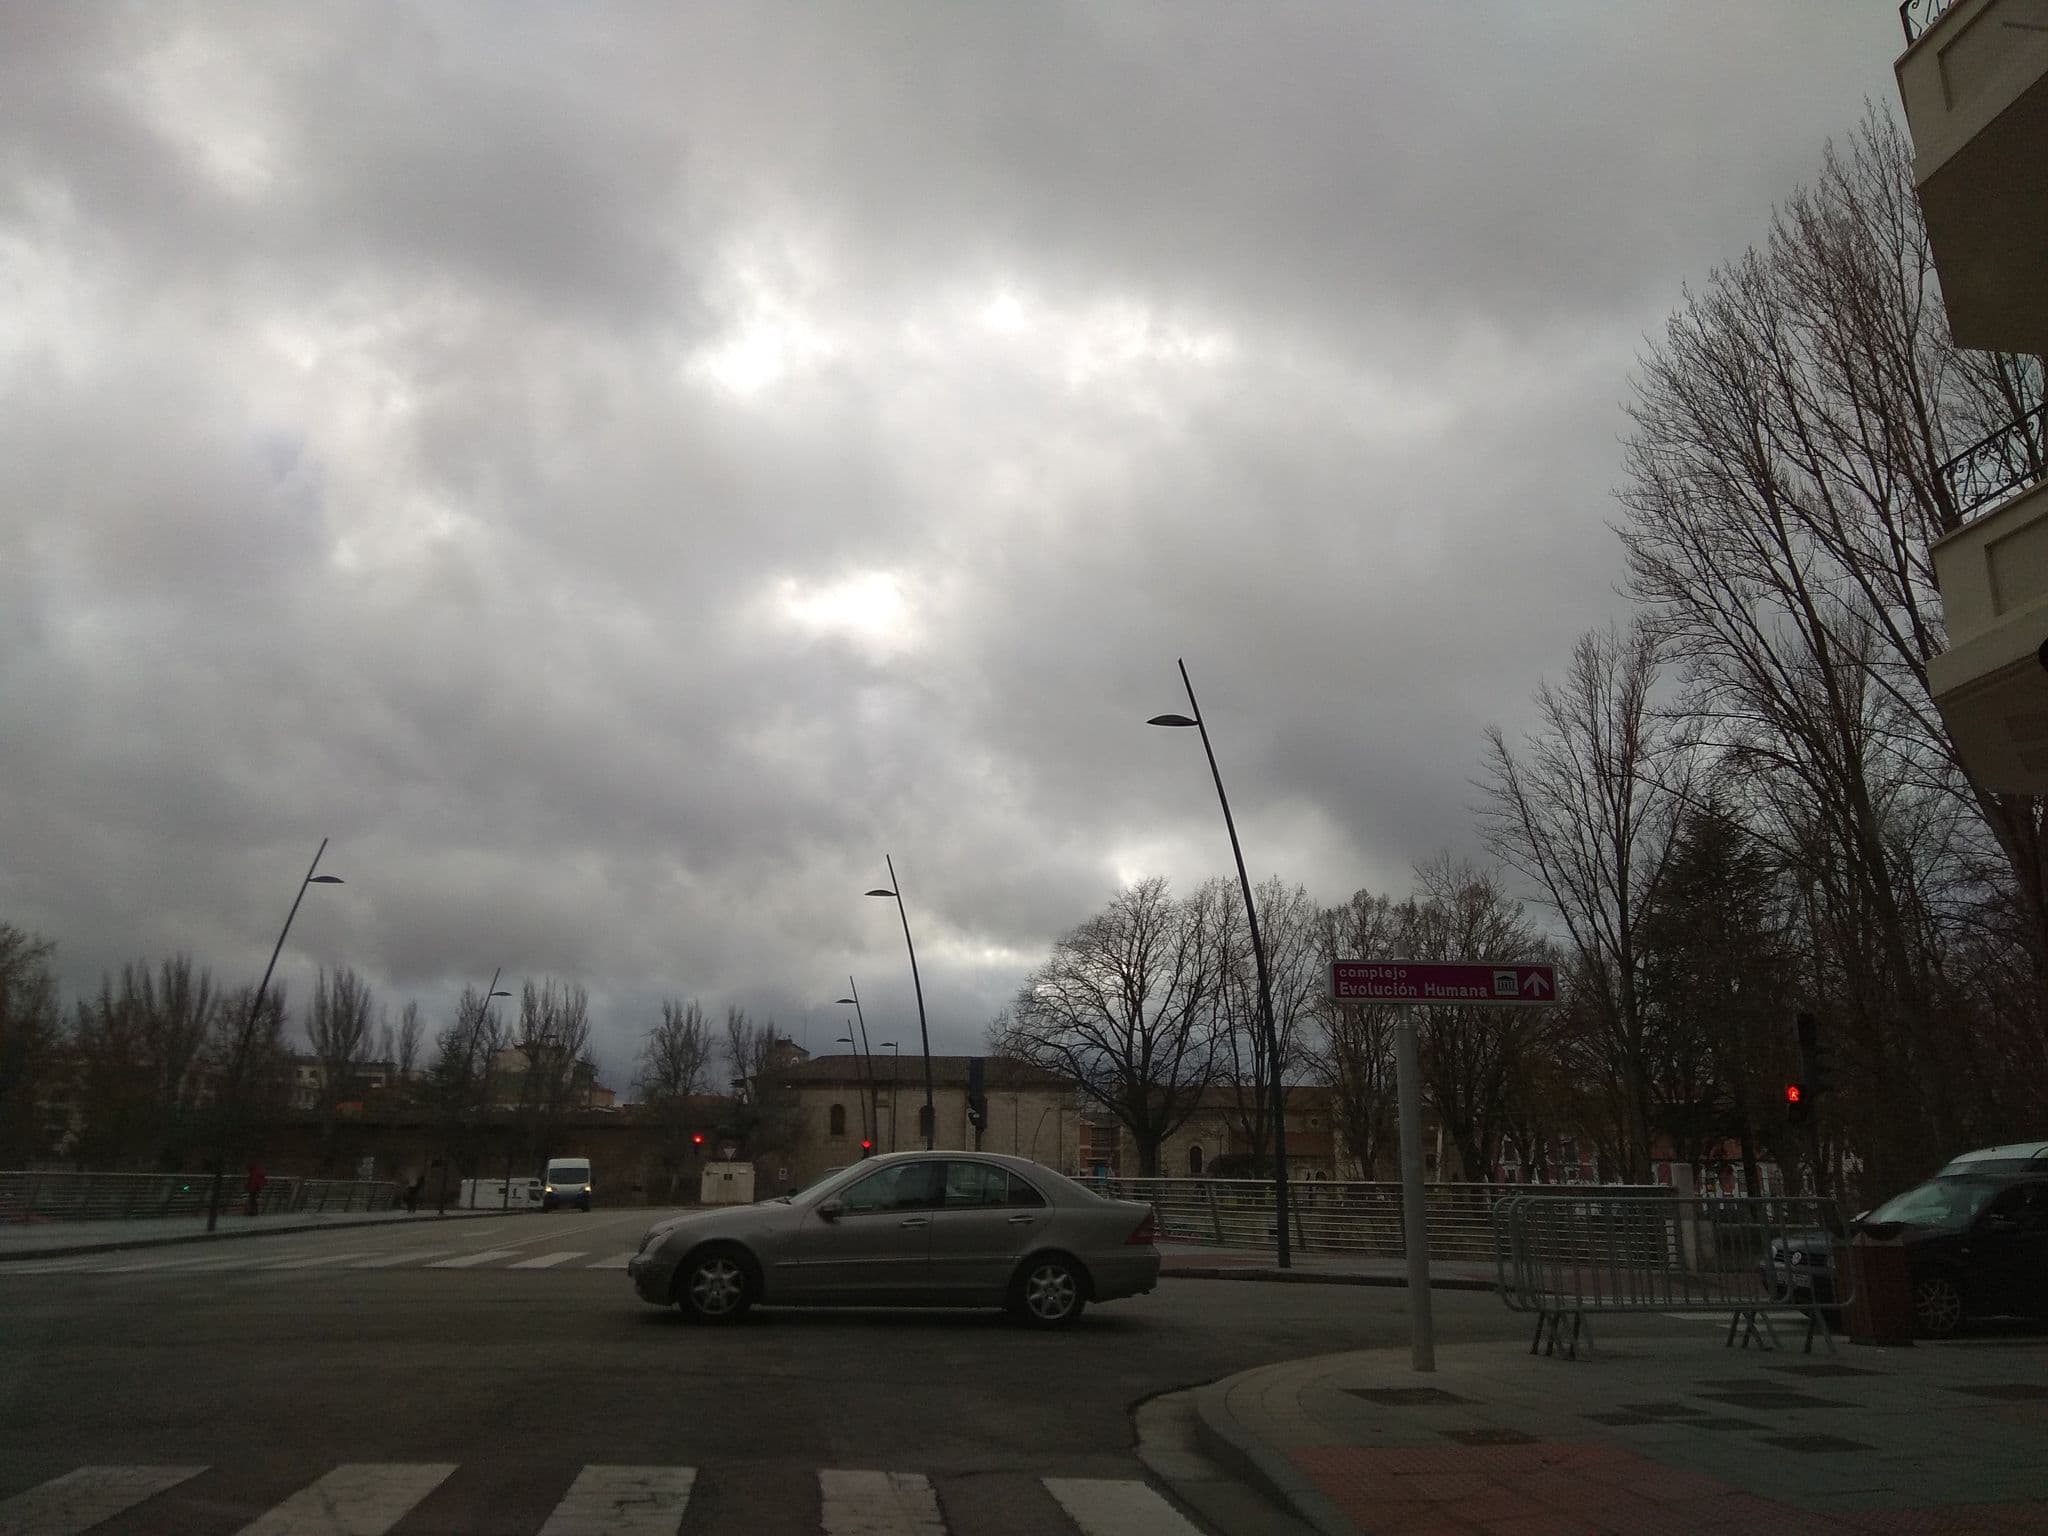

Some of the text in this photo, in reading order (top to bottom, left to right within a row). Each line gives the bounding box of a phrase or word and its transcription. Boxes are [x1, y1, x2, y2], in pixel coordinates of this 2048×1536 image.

[1339, 967, 1408, 981] complejo
[1339, 982, 1488, 998] Evolución Humana
